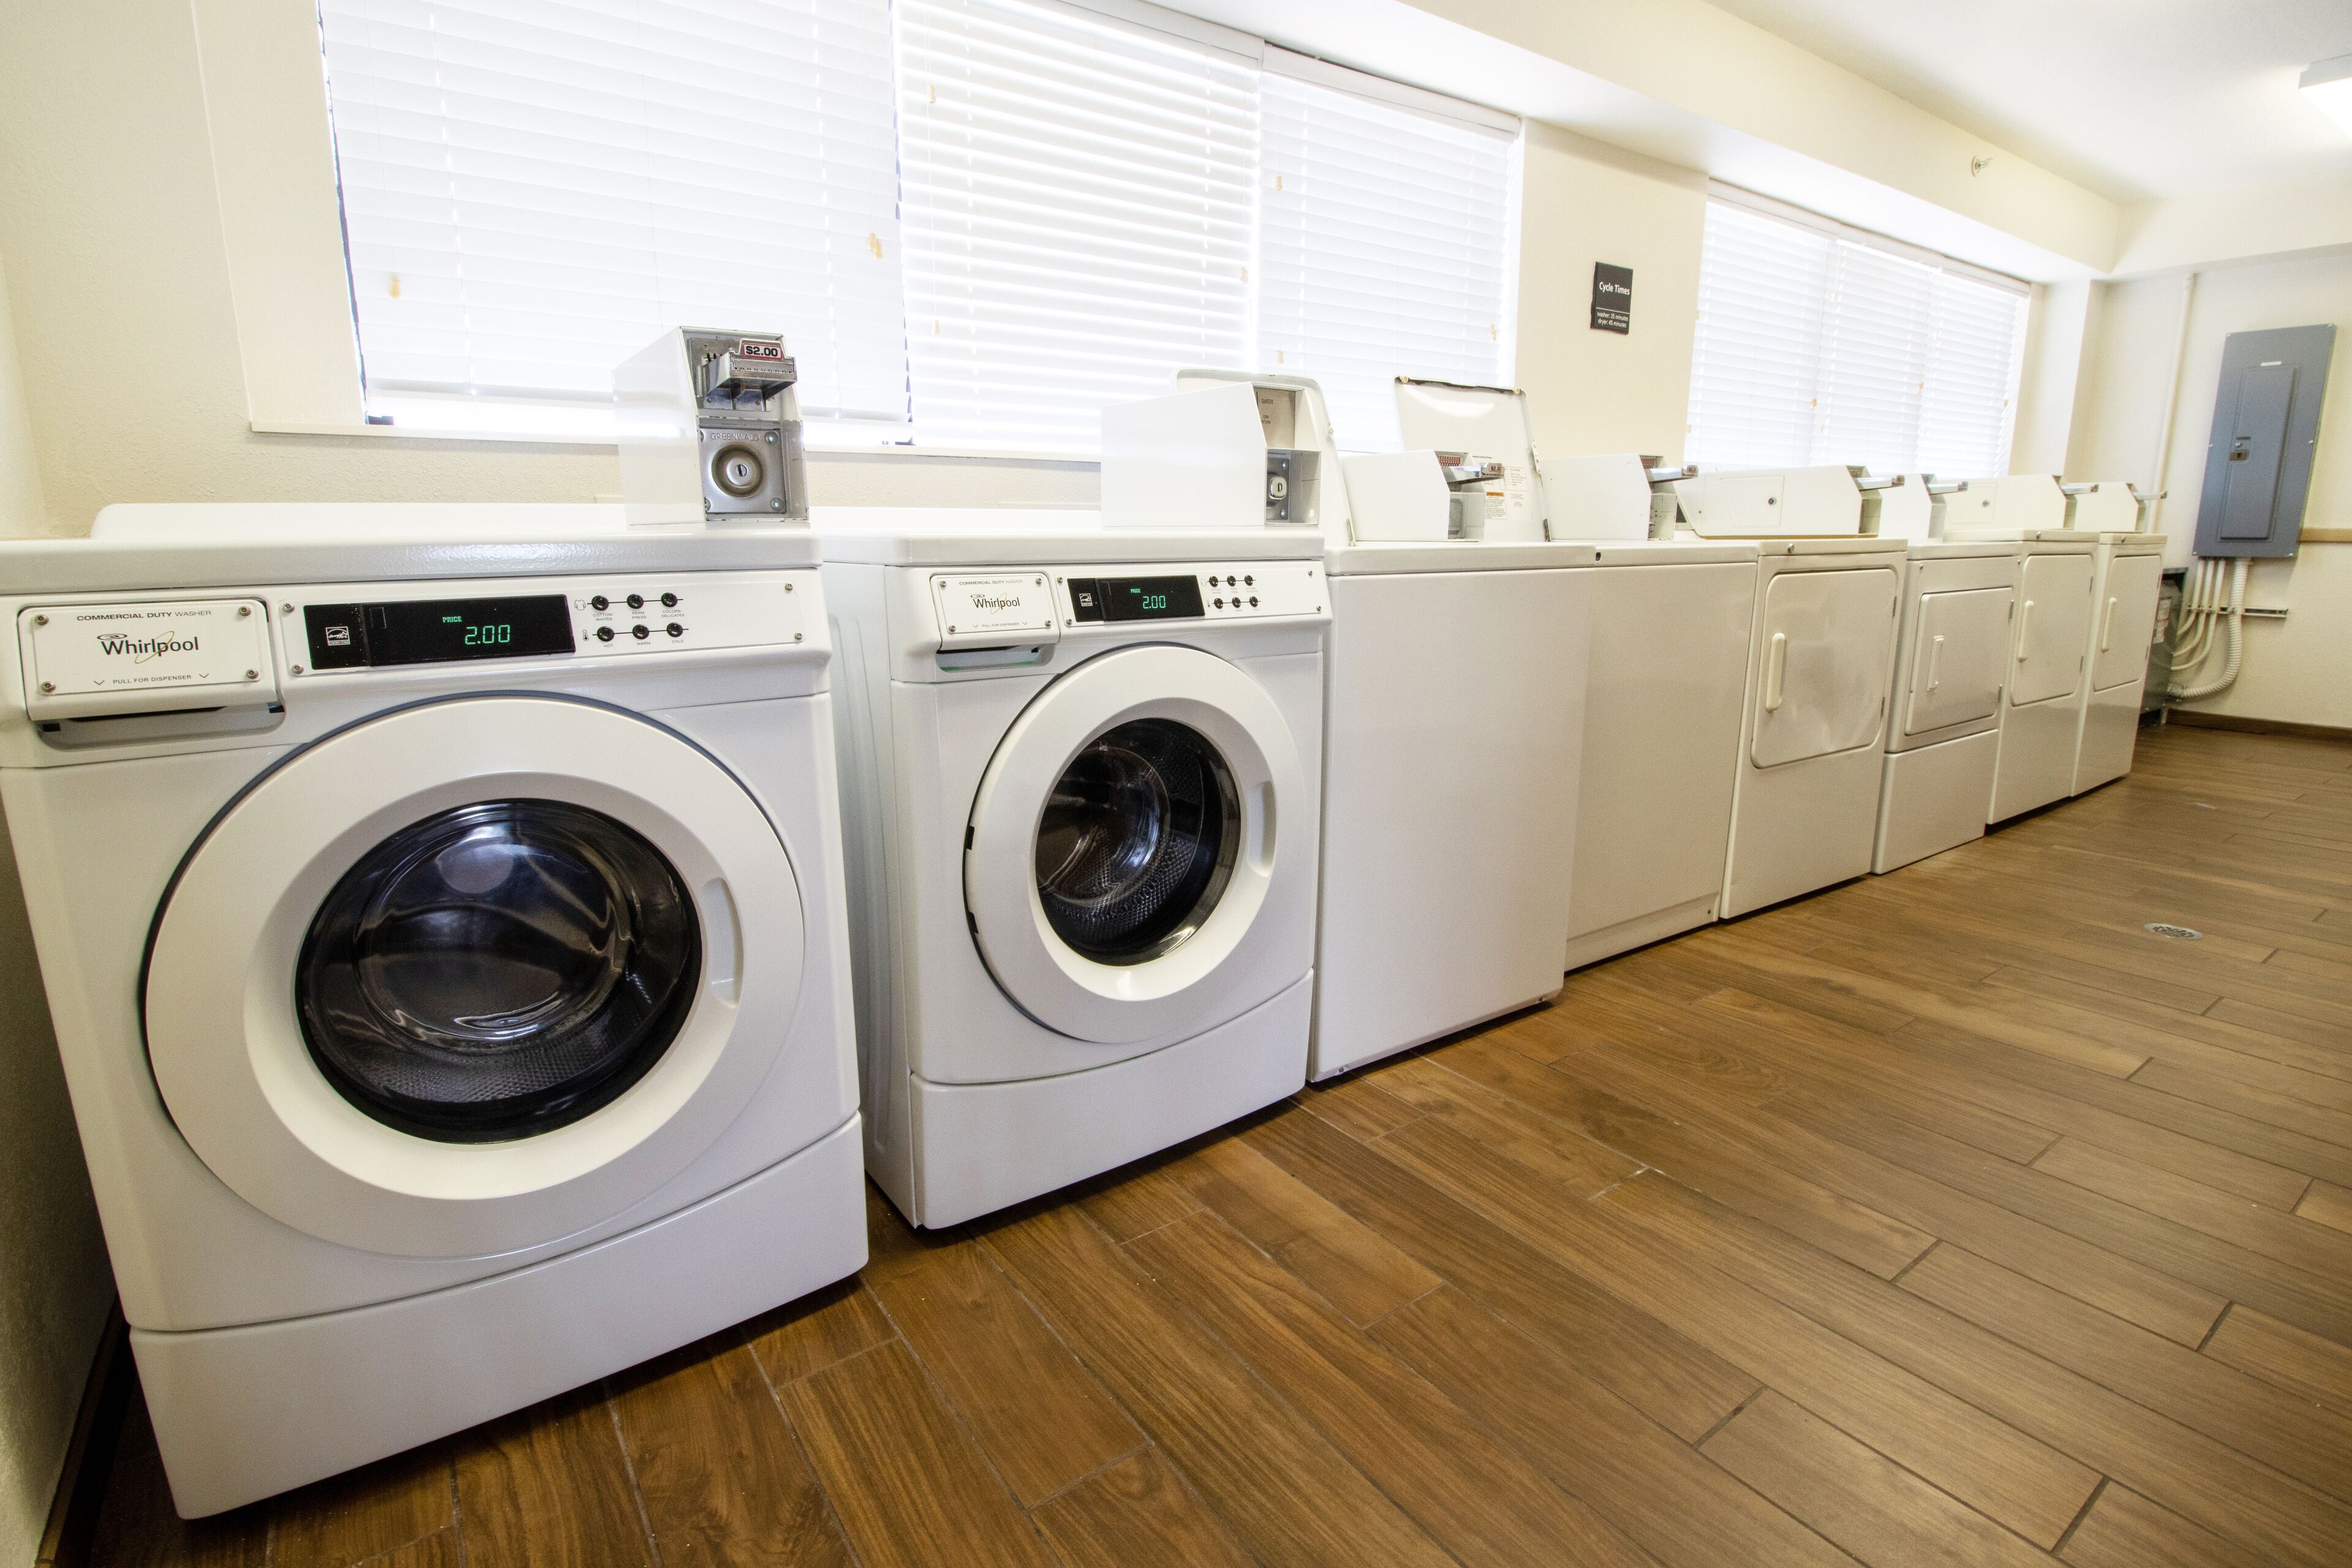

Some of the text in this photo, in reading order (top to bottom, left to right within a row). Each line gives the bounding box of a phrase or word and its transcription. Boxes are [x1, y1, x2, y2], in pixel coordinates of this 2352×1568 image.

[1599, 282, 1630, 295] Cycle Times
[745, 345, 777, 356] $2.00
[711, 432, 760, 442] GREENWALD
[973, 597, 1020, 610] Whirlpool
[1142, 595, 1166, 609] 2.00
[465, 625, 510, 645] 2.00
[100, 636, 198, 657] Whirlpool
